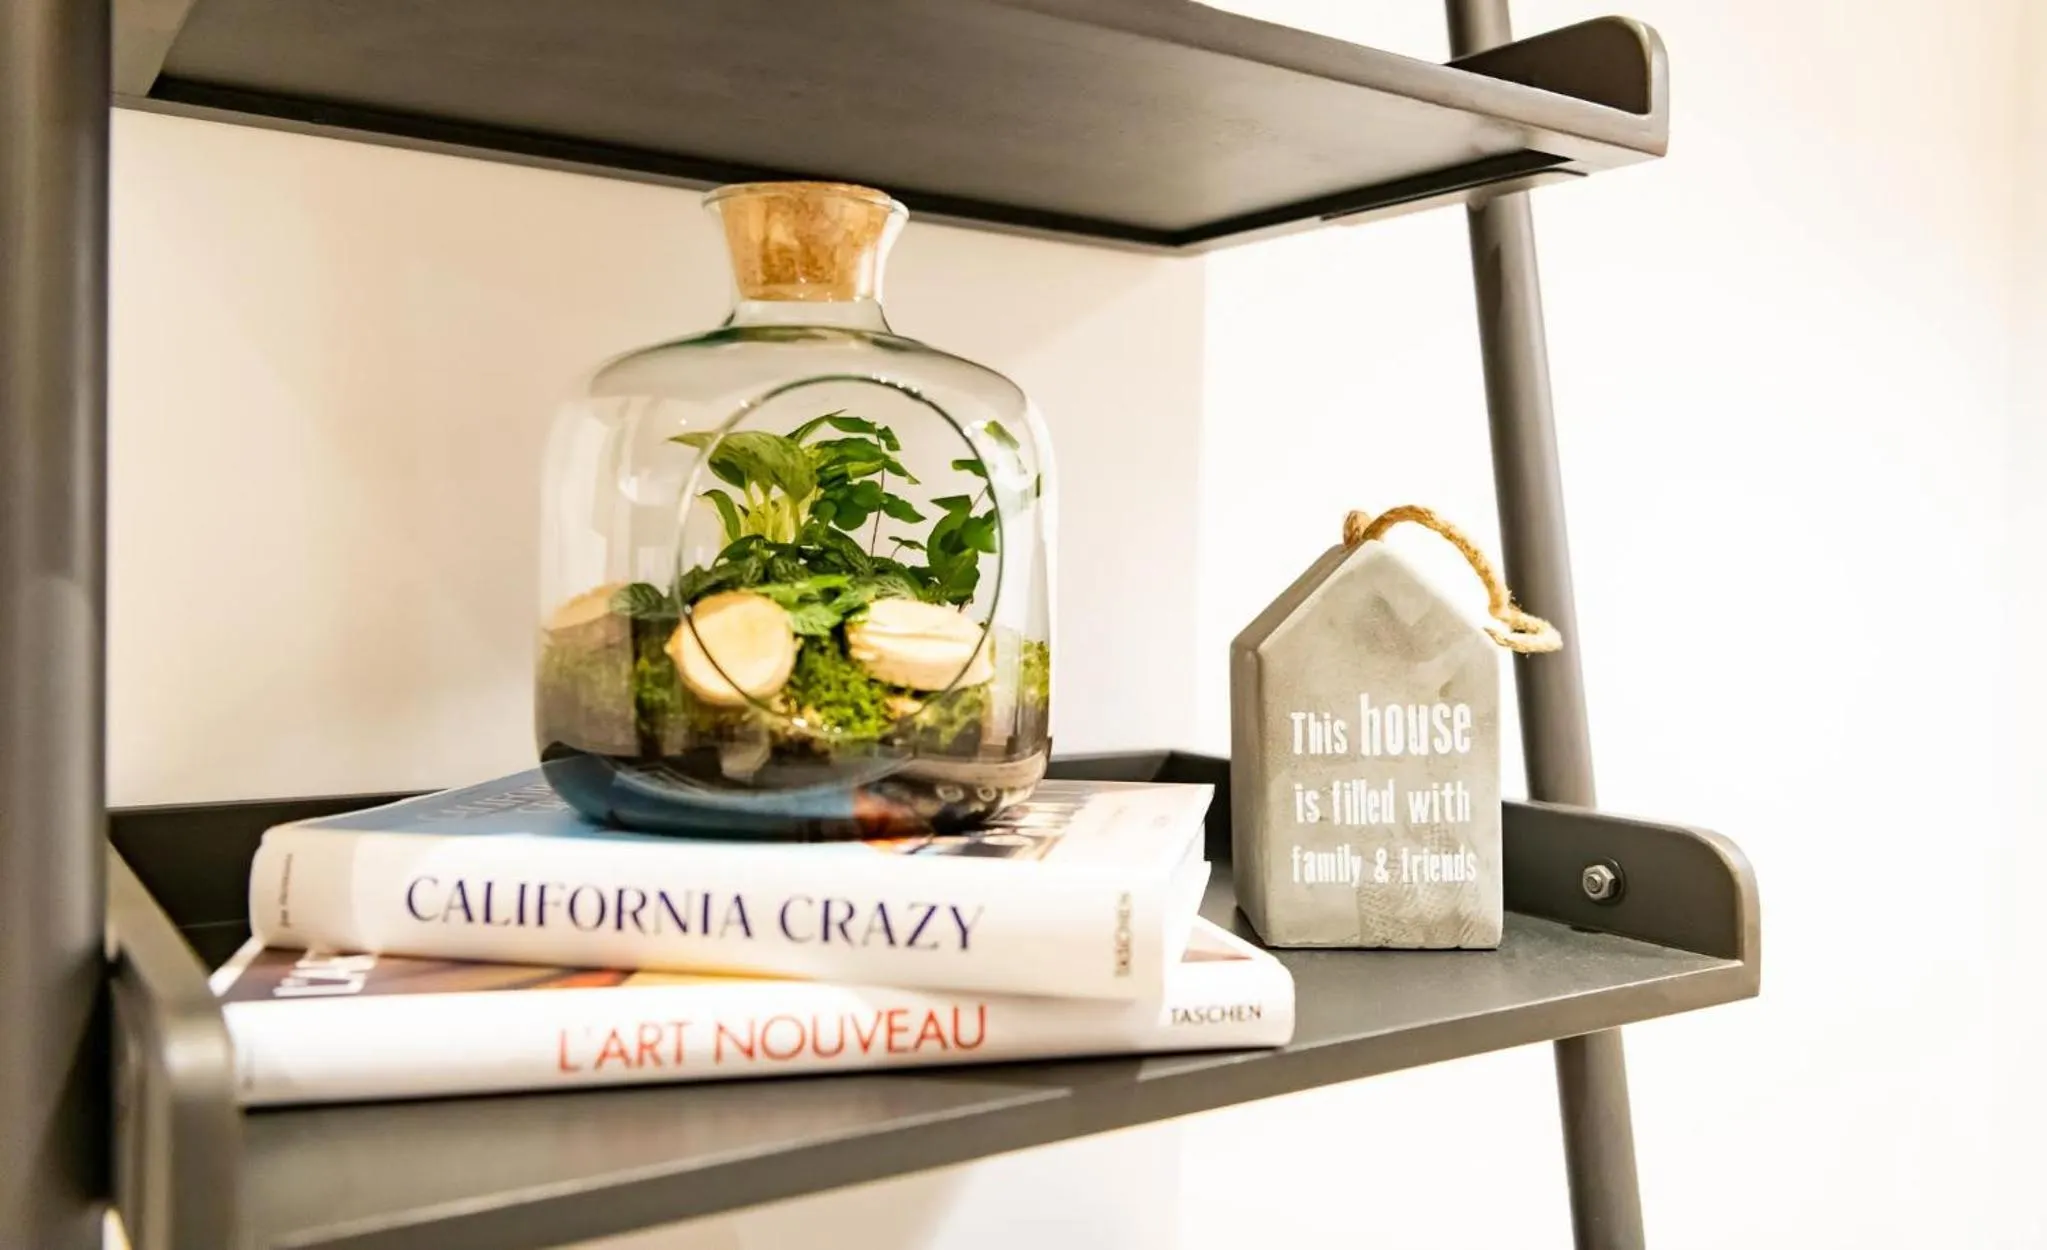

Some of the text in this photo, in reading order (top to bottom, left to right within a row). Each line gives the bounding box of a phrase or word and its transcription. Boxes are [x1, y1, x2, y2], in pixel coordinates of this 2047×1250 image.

[1290, 692, 1472, 756] This house
[1294, 778, 1470, 825] is filled with
[1291, 844, 1477, 888] family & friends
[405, 875, 985, 951] CALIFORNIA CRAZY
[557, 1003, 987, 1074] L'ART NOUVEAU
[1169, 1003, 1262, 1026] TASCHEN
